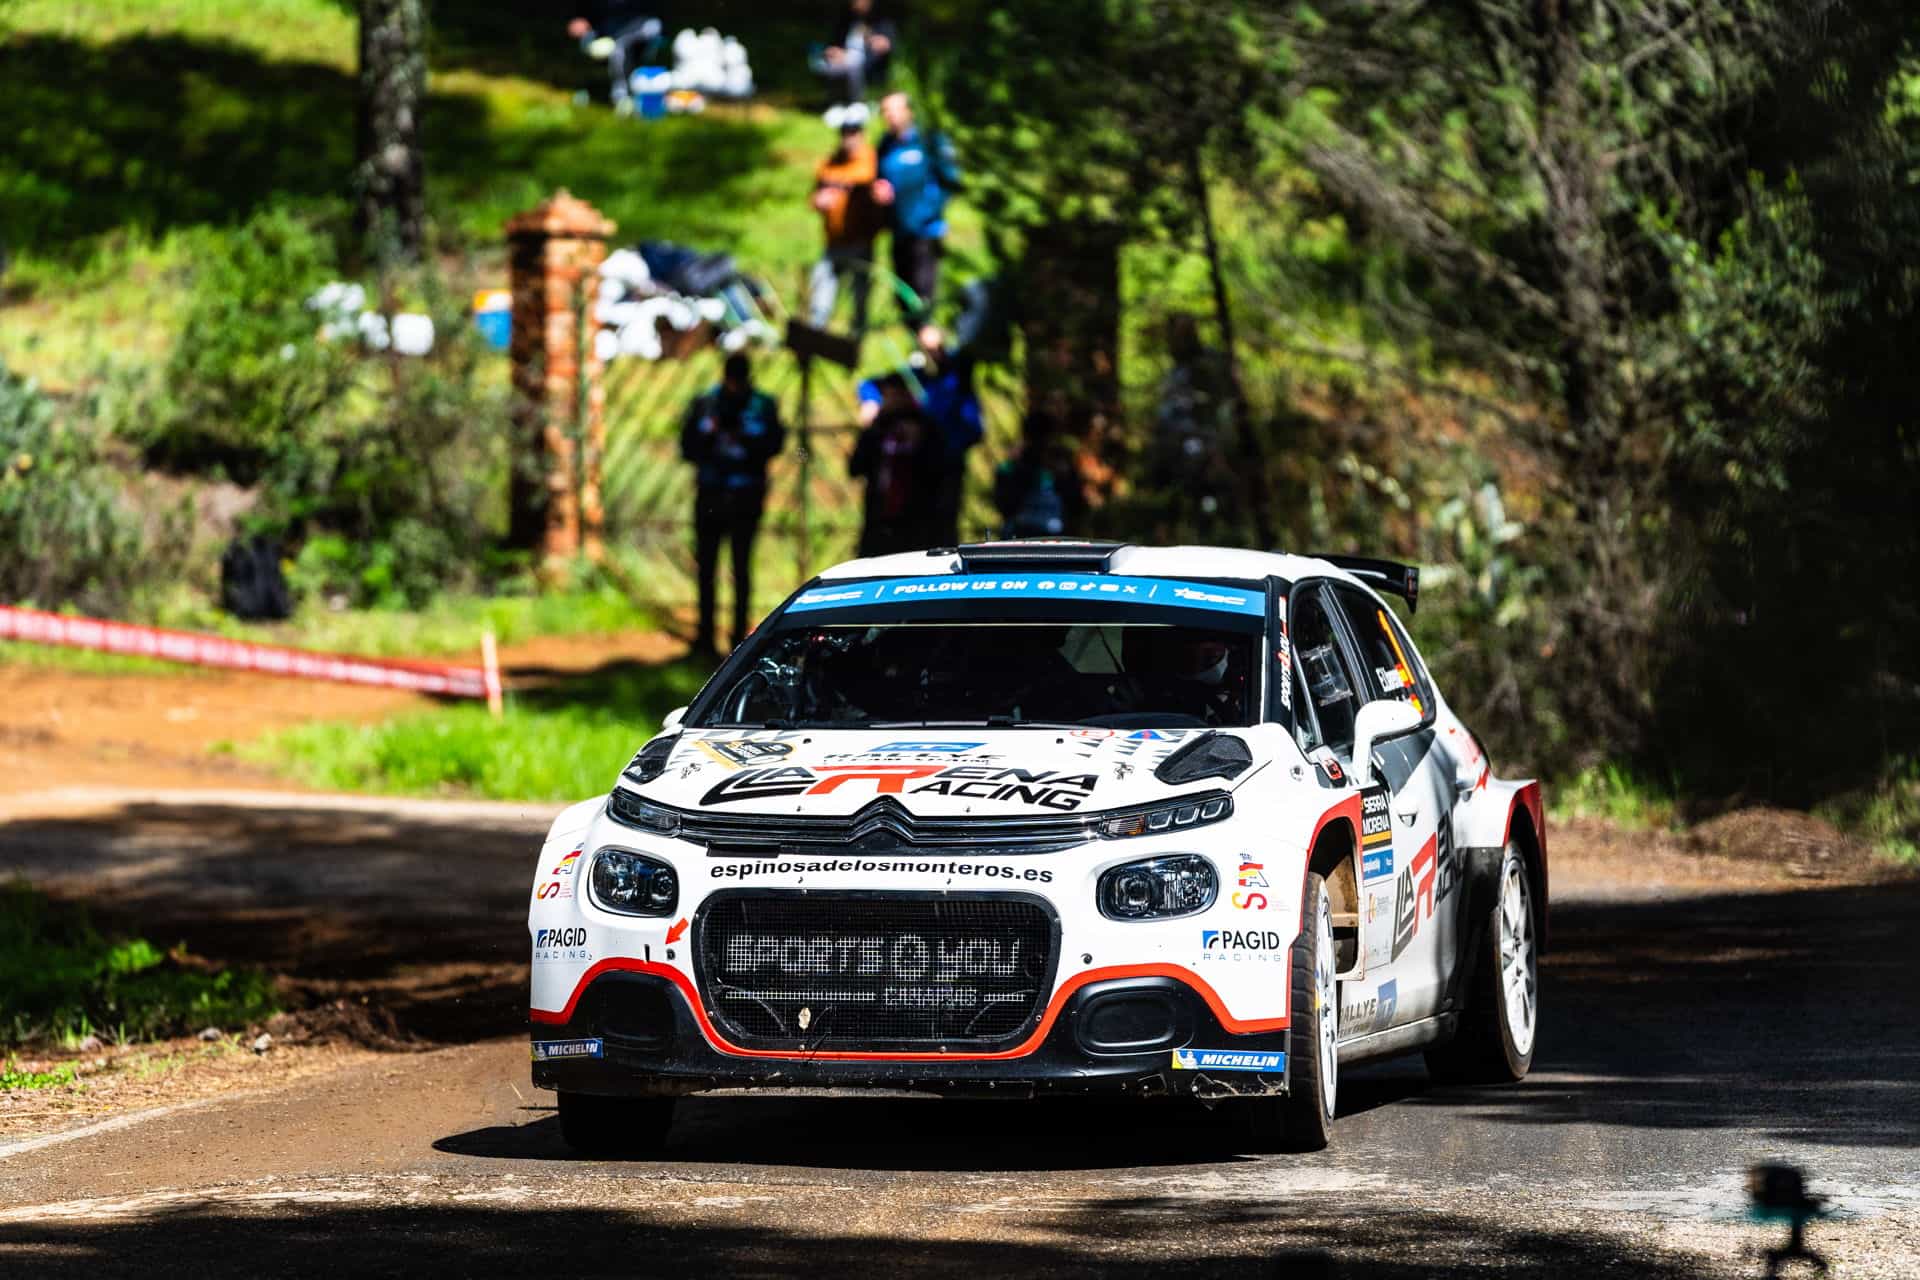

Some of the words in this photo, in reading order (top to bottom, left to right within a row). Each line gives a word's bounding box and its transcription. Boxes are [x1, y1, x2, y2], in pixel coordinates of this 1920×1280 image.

[894, 582, 970, 595] FOLLOW
[972, 581, 998, 591] US
[1001, 581, 1028, 590] ON
[1362, 813, 1390, 835] MORENA
[710, 859, 1054, 882] espinosadelosmonteros.es
[548, 928, 587, 949] PAGID
[1222, 930, 1280, 950] PAGID
[535, 950, 586, 960] RACING
[1203, 953, 1281, 962] RACING
[548, 1043, 598, 1056] MICHELIN
[1201, 1054, 1280, 1067] MICHELIN
